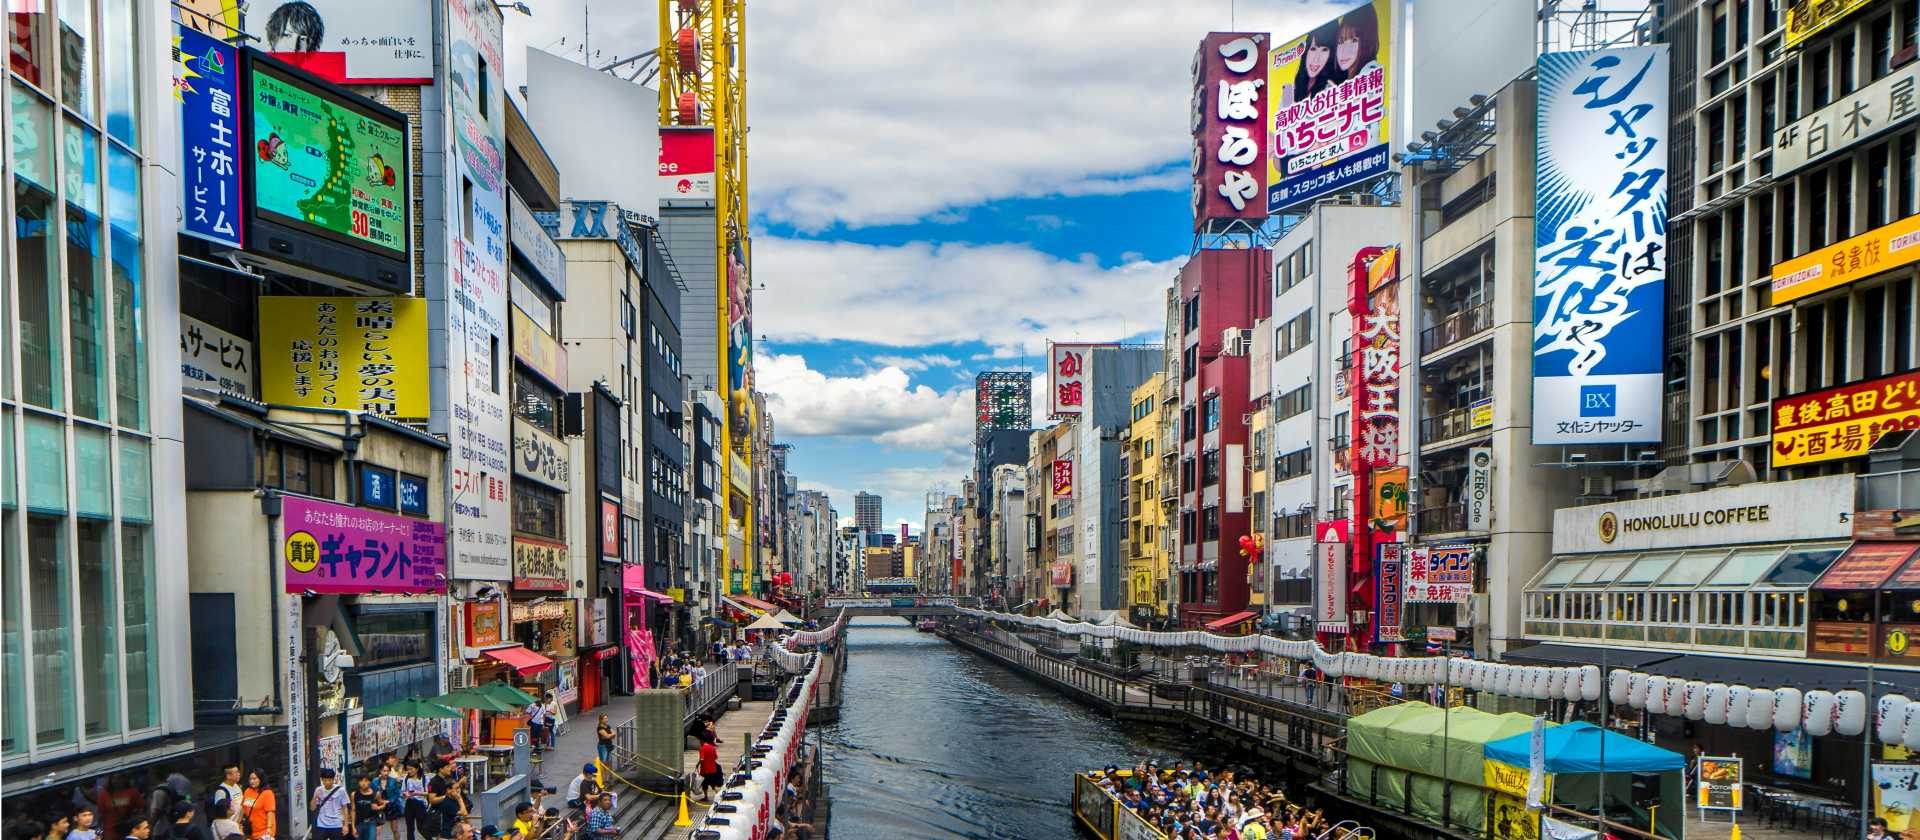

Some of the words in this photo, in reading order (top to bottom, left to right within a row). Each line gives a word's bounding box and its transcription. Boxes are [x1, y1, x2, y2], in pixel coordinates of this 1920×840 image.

[341, 36, 415, 46] めっちゃ面白いを
[1275, 68, 1384, 131] 高収入お仕事情報
[1778, 125, 1800, 149] 4F
[1805, 76, 1918, 161] 白木屋
[1219, 34, 1265, 211] づぼらや
[1274, 88, 1384, 158] いちごナビ
[209, 87, 235, 237] 富士ホーム
[1290, 148, 1327, 171] いちごナビ
[192, 146, 209, 224] サービス
[352, 210, 368, 237] 30
[291, 340, 312, 397] 応援します
[318, 303, 338, 406] あなたのお店づくり
[1360, 305, 1399, 467] 大阪王将
[1586, 393, 1612, 409] BX
[1556, 419, 1643, 434] 文化シャッター
[1797, 424, 1865, 457] 酒場
[1474, 469, 1485, 500] ZERO
[1624, 513, 1699, 532] HONOLULU
[1703, 504, 1769, 525] COFFEE
[291, 541, 316, 563] 賃貸
[321, 532, 412, 579] ギャラント
[1431, 552, 1470, 571] ダイコク
[1427, 585, 1452, 600] 免税
